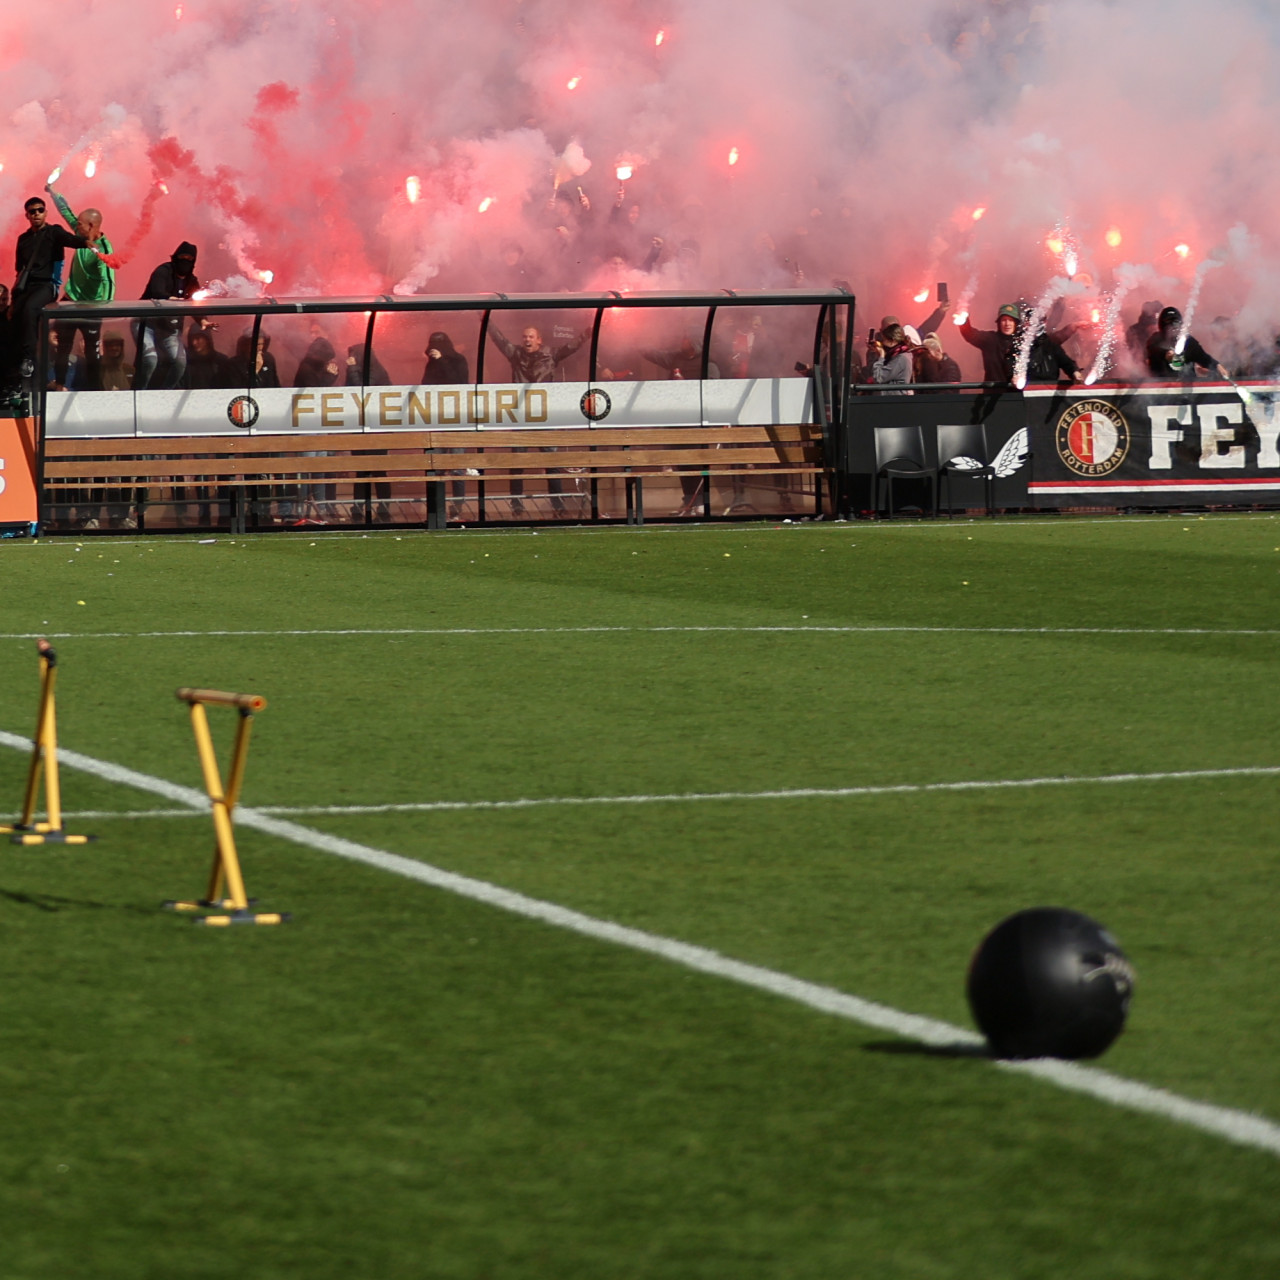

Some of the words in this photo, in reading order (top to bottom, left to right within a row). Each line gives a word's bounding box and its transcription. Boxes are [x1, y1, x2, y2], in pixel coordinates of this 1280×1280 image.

[292, 389, 548, 427] FEYENOORD
[1061, 403, 1122, 429] FEYENOORD
[1061, 447, 1124, 474] ROTTERDAM
